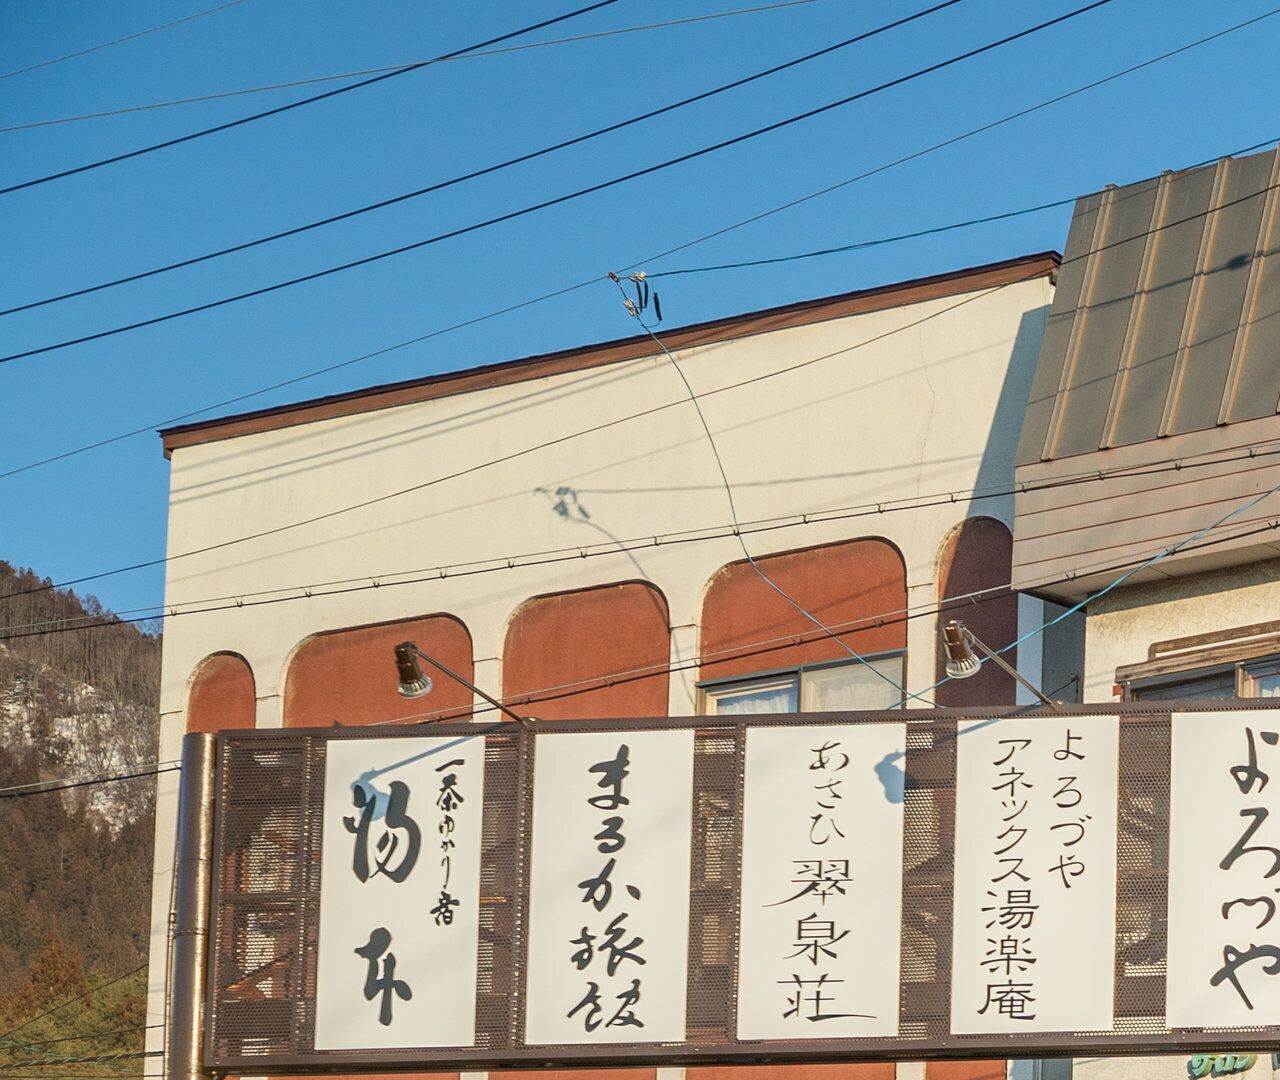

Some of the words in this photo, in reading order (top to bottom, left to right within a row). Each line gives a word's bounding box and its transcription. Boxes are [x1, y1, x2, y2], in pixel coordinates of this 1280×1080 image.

[566, 743, 647, 1032] まるか旅館
[762, 741, 878, 1023] あさひ翠泉荘
[977, 738, 1040, 1022] アネックス湯楽庵
[1048, 728, 1094, 890] よろづや
